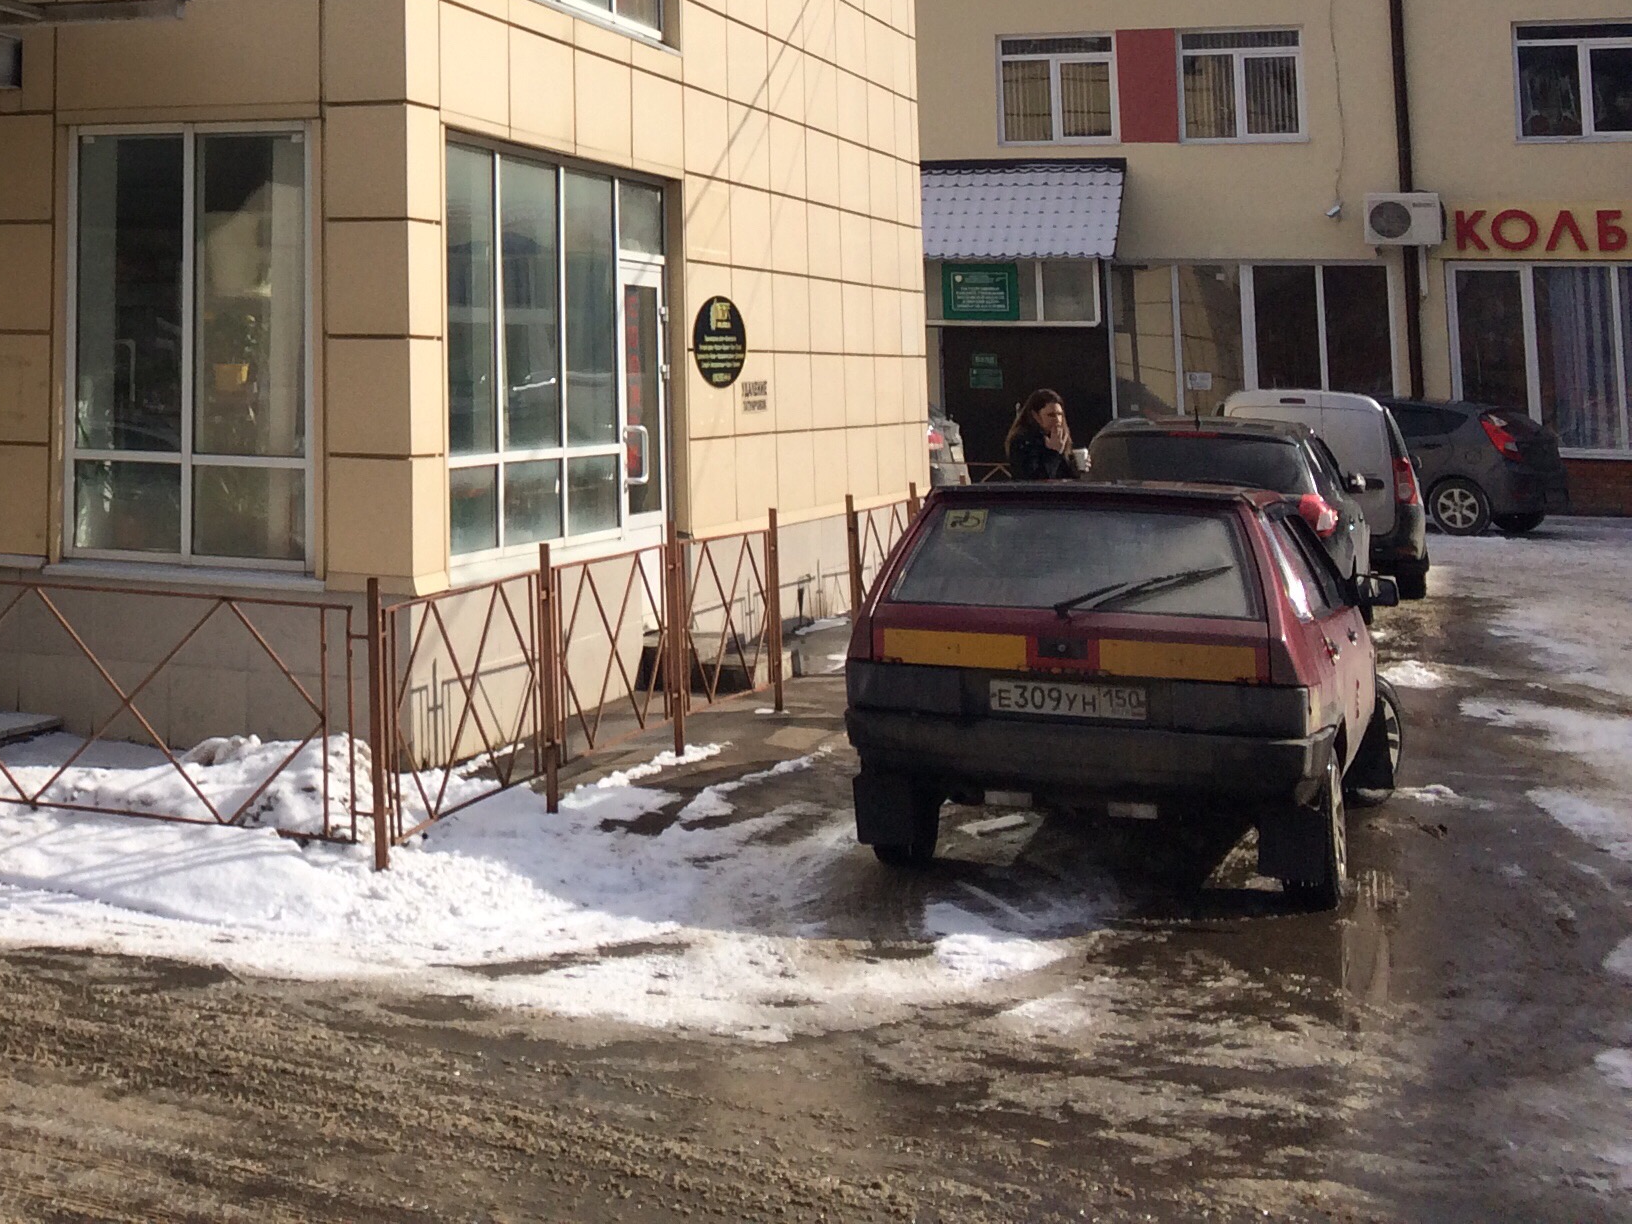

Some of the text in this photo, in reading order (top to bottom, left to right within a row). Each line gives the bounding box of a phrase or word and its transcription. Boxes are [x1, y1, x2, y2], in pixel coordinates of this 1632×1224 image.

[1454, 209, 1628, 252] КОЛБ
[997, 685, 1097, 713] Е309УН
[1103, 688, 1140, 709] 150
